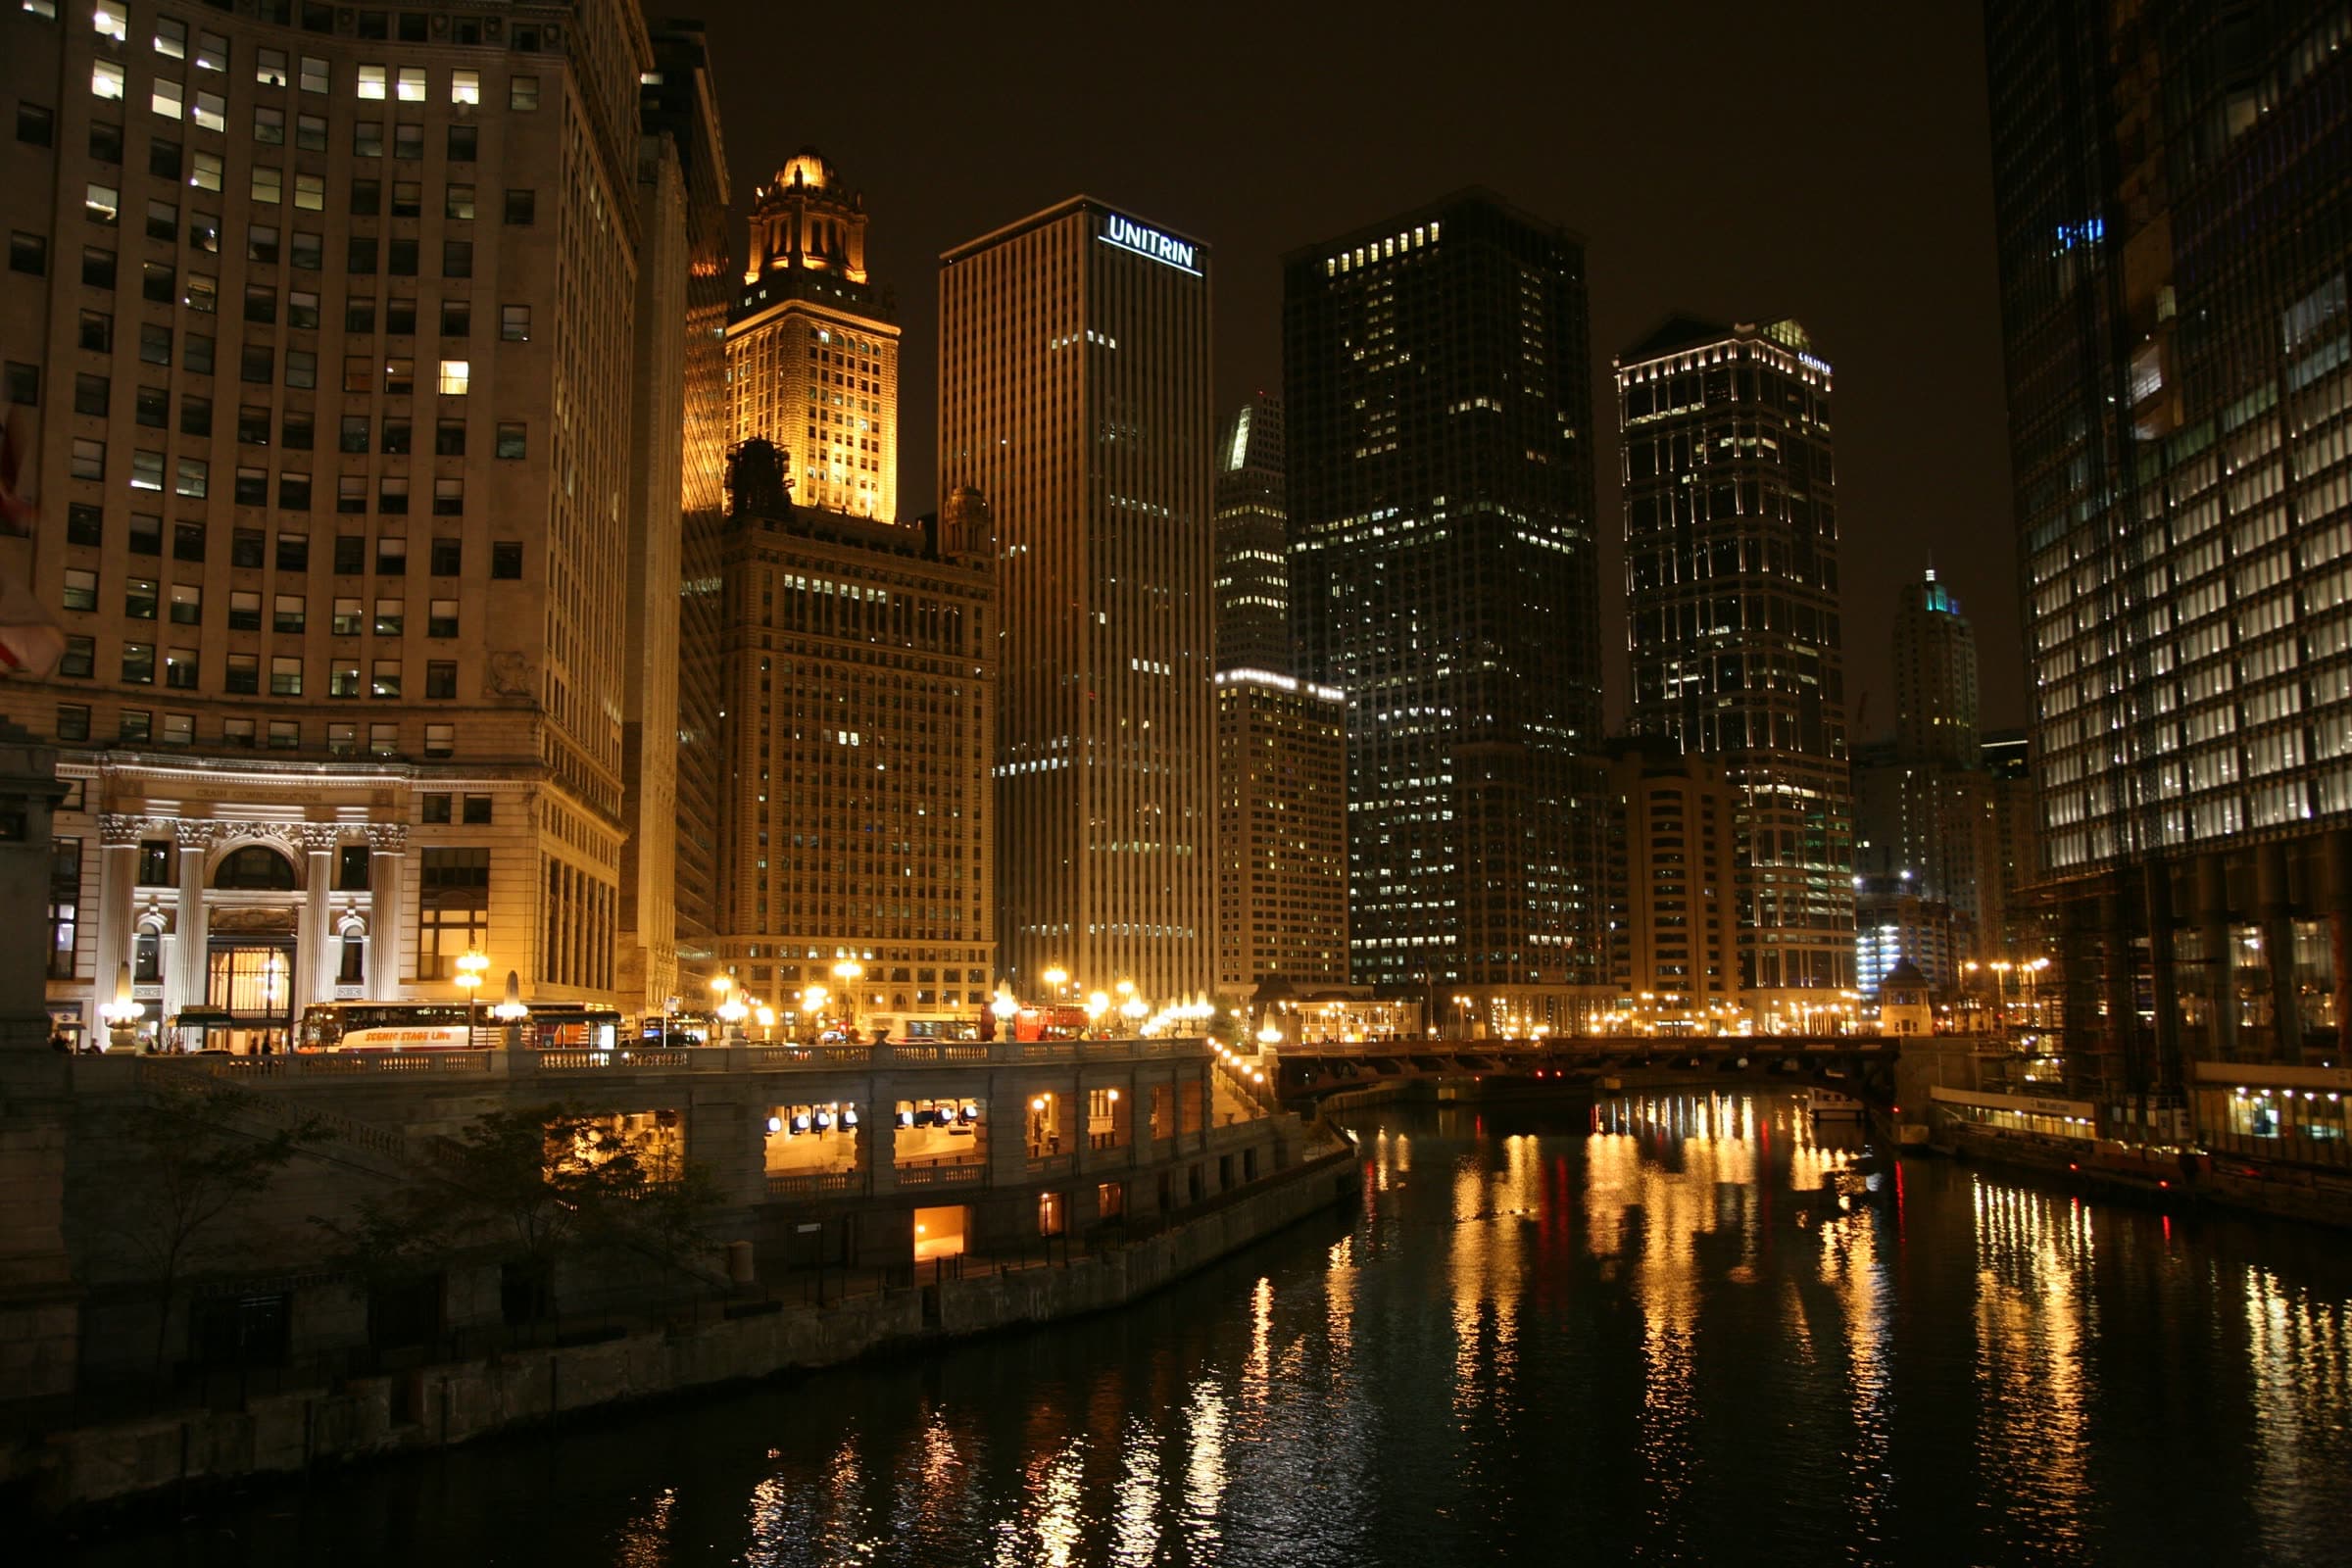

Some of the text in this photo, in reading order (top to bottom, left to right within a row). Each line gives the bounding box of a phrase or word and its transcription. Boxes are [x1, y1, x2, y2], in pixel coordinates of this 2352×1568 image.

[1109, 215, 1193, 268] UNITRIN
[400, 1031, 428, 1041] STAGE
[431, 1031, 451, 1040] LINE
